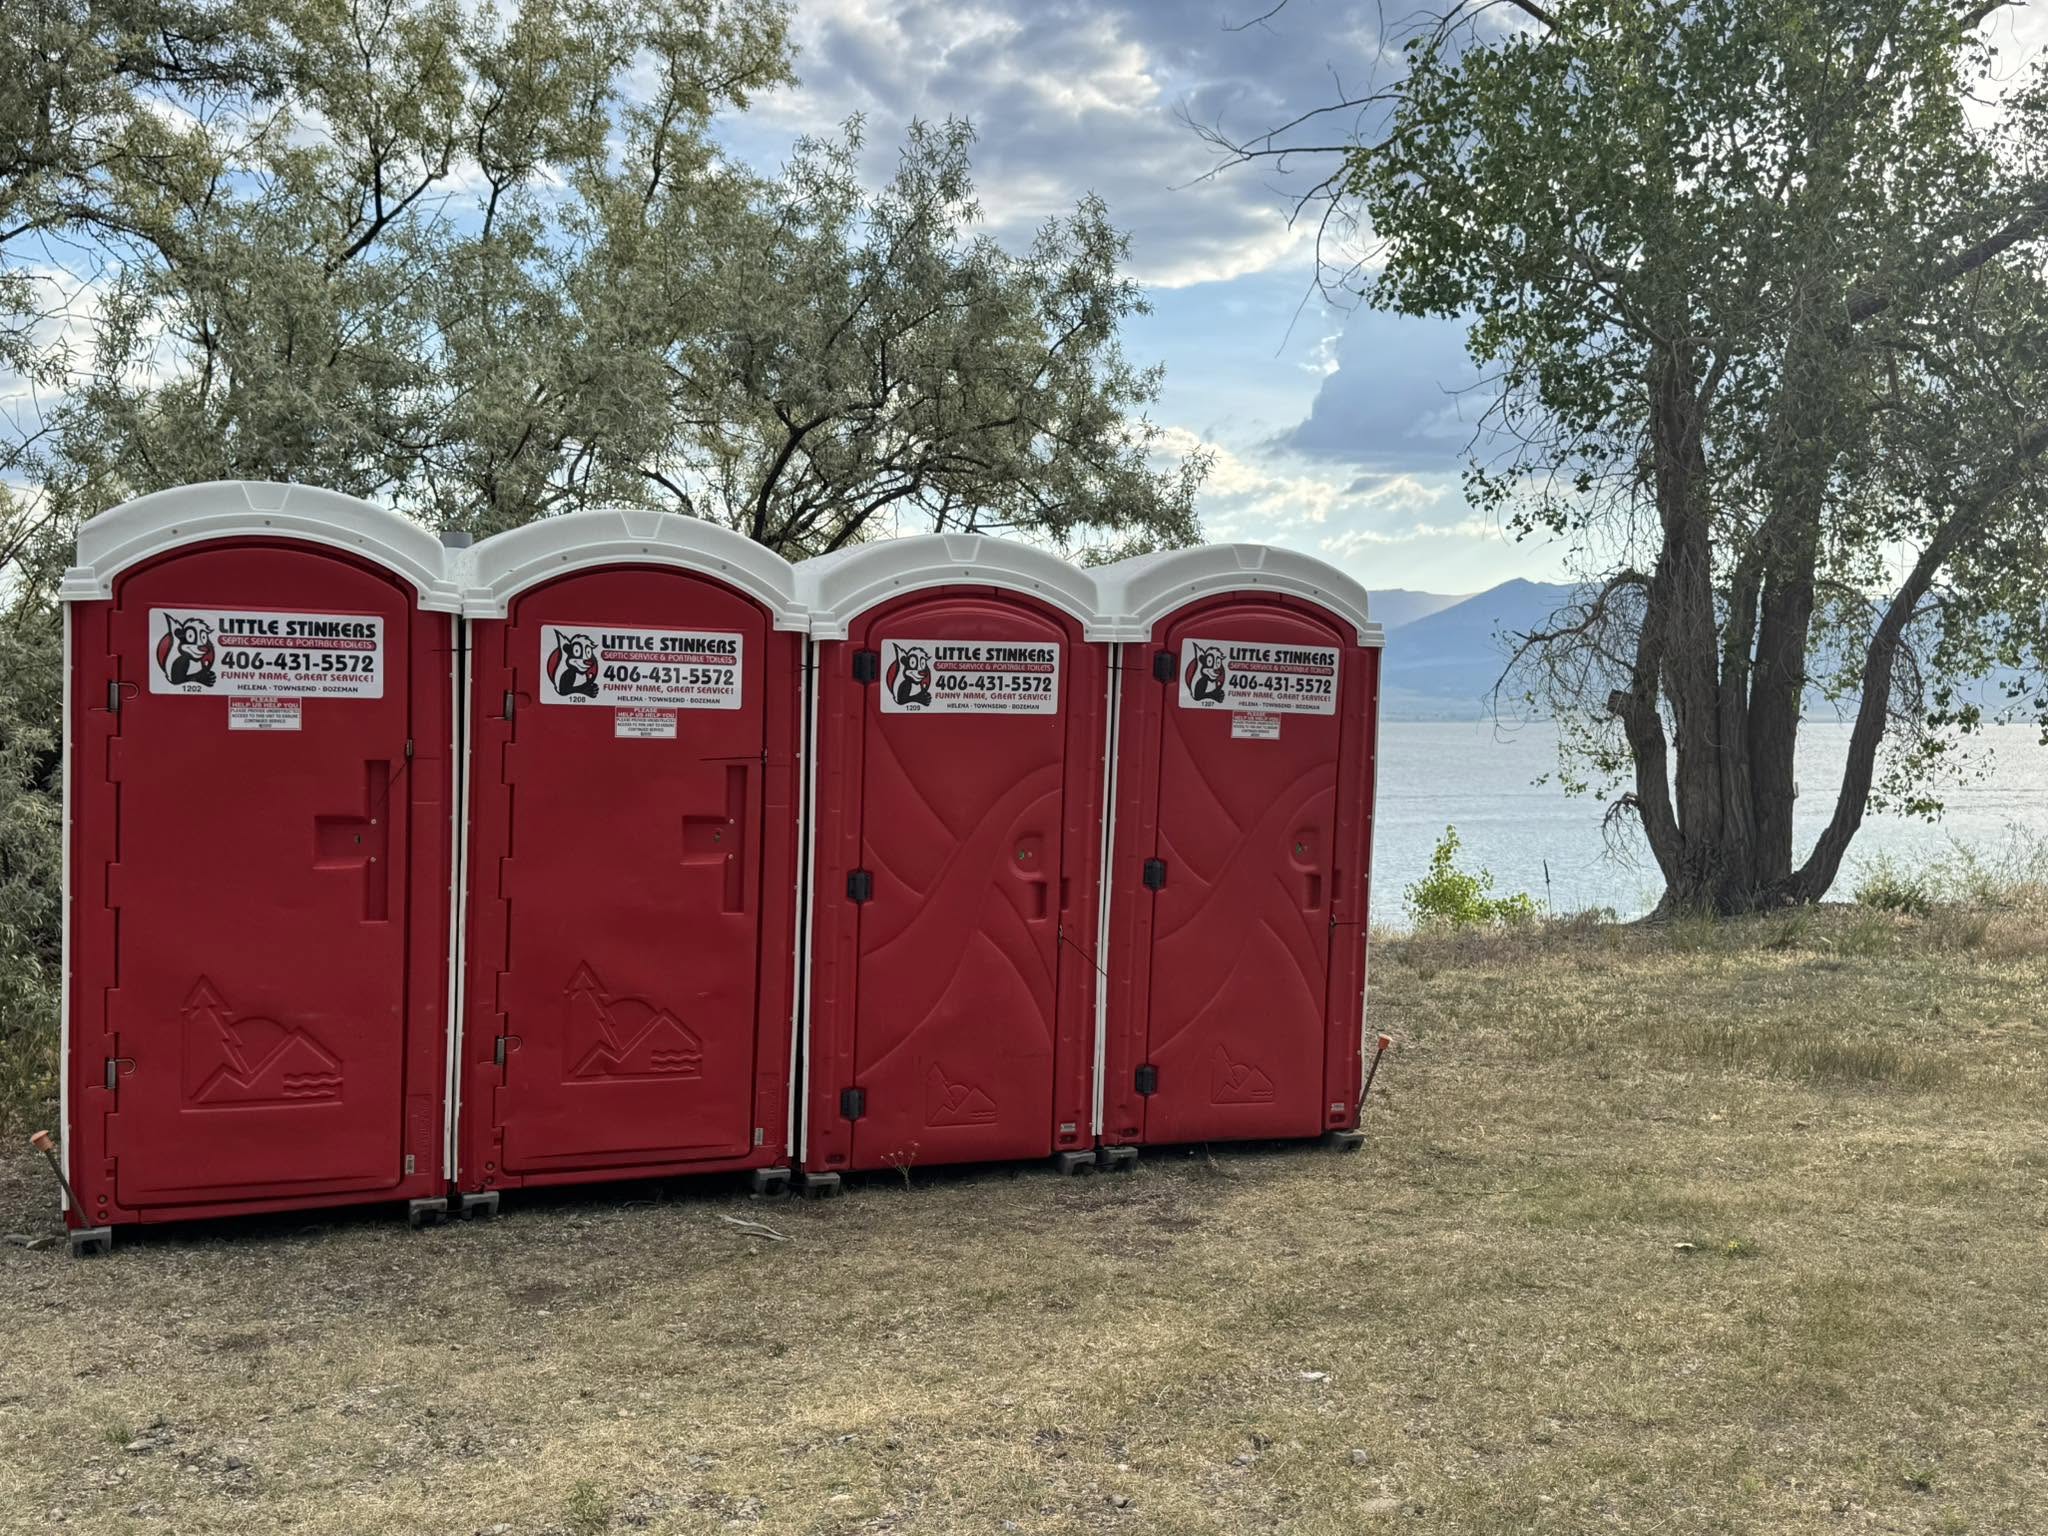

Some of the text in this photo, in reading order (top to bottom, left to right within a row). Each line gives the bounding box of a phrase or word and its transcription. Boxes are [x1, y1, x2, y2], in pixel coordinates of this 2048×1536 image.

[219, 618, 376, 638] LITTLE STINKERS
[221, 637, 372, 649] SEPTIC SERVICE & PORTABLE TOILETS
[602, 634, 736, 653] LITTLE STINKERS
[221, 652, 374, 672] 406-431-5572
[668, 654, 704, 663] PORTABLE
[706, 656, 733, 664] TOILETS
[935, 647, 1054, 662] LITTLE STINKERS
[1230, 648, 1334, 665] LITTLE STINKERS
[221, 672, 374, 682] FUNNY NAME, GREAT SERVICE!
[603, 665, 734, 685] 406-431-5572
[936, 675, 1051, 692] 406-431-5572
[636, 685, 664, 693] NAME,
[1229, 675, 1331, 693] 406-431-5572
